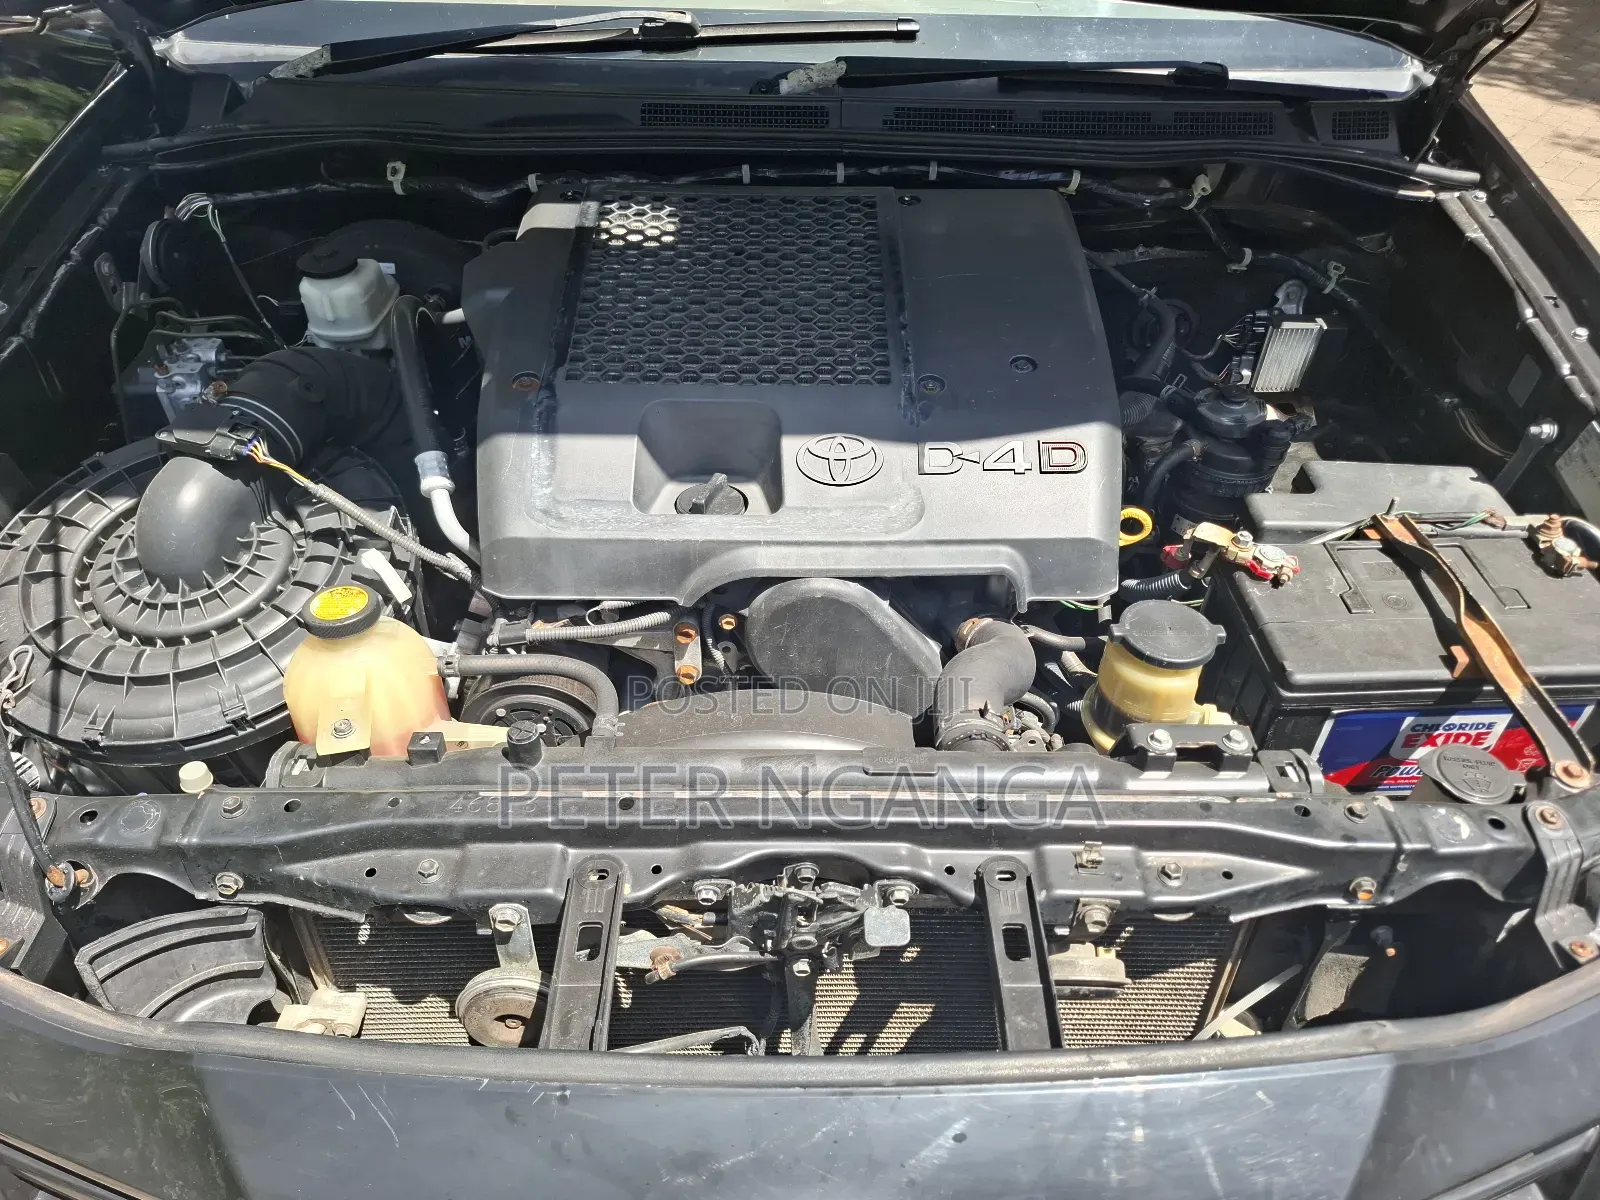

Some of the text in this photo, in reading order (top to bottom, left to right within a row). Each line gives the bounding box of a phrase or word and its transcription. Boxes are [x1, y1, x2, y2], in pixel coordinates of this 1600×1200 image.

[917, 440, 1088, 475] D-4D
[1411, 722, 1497, 733] CHLORIDE
[1401, 731, 1492, 748] EXIDE
